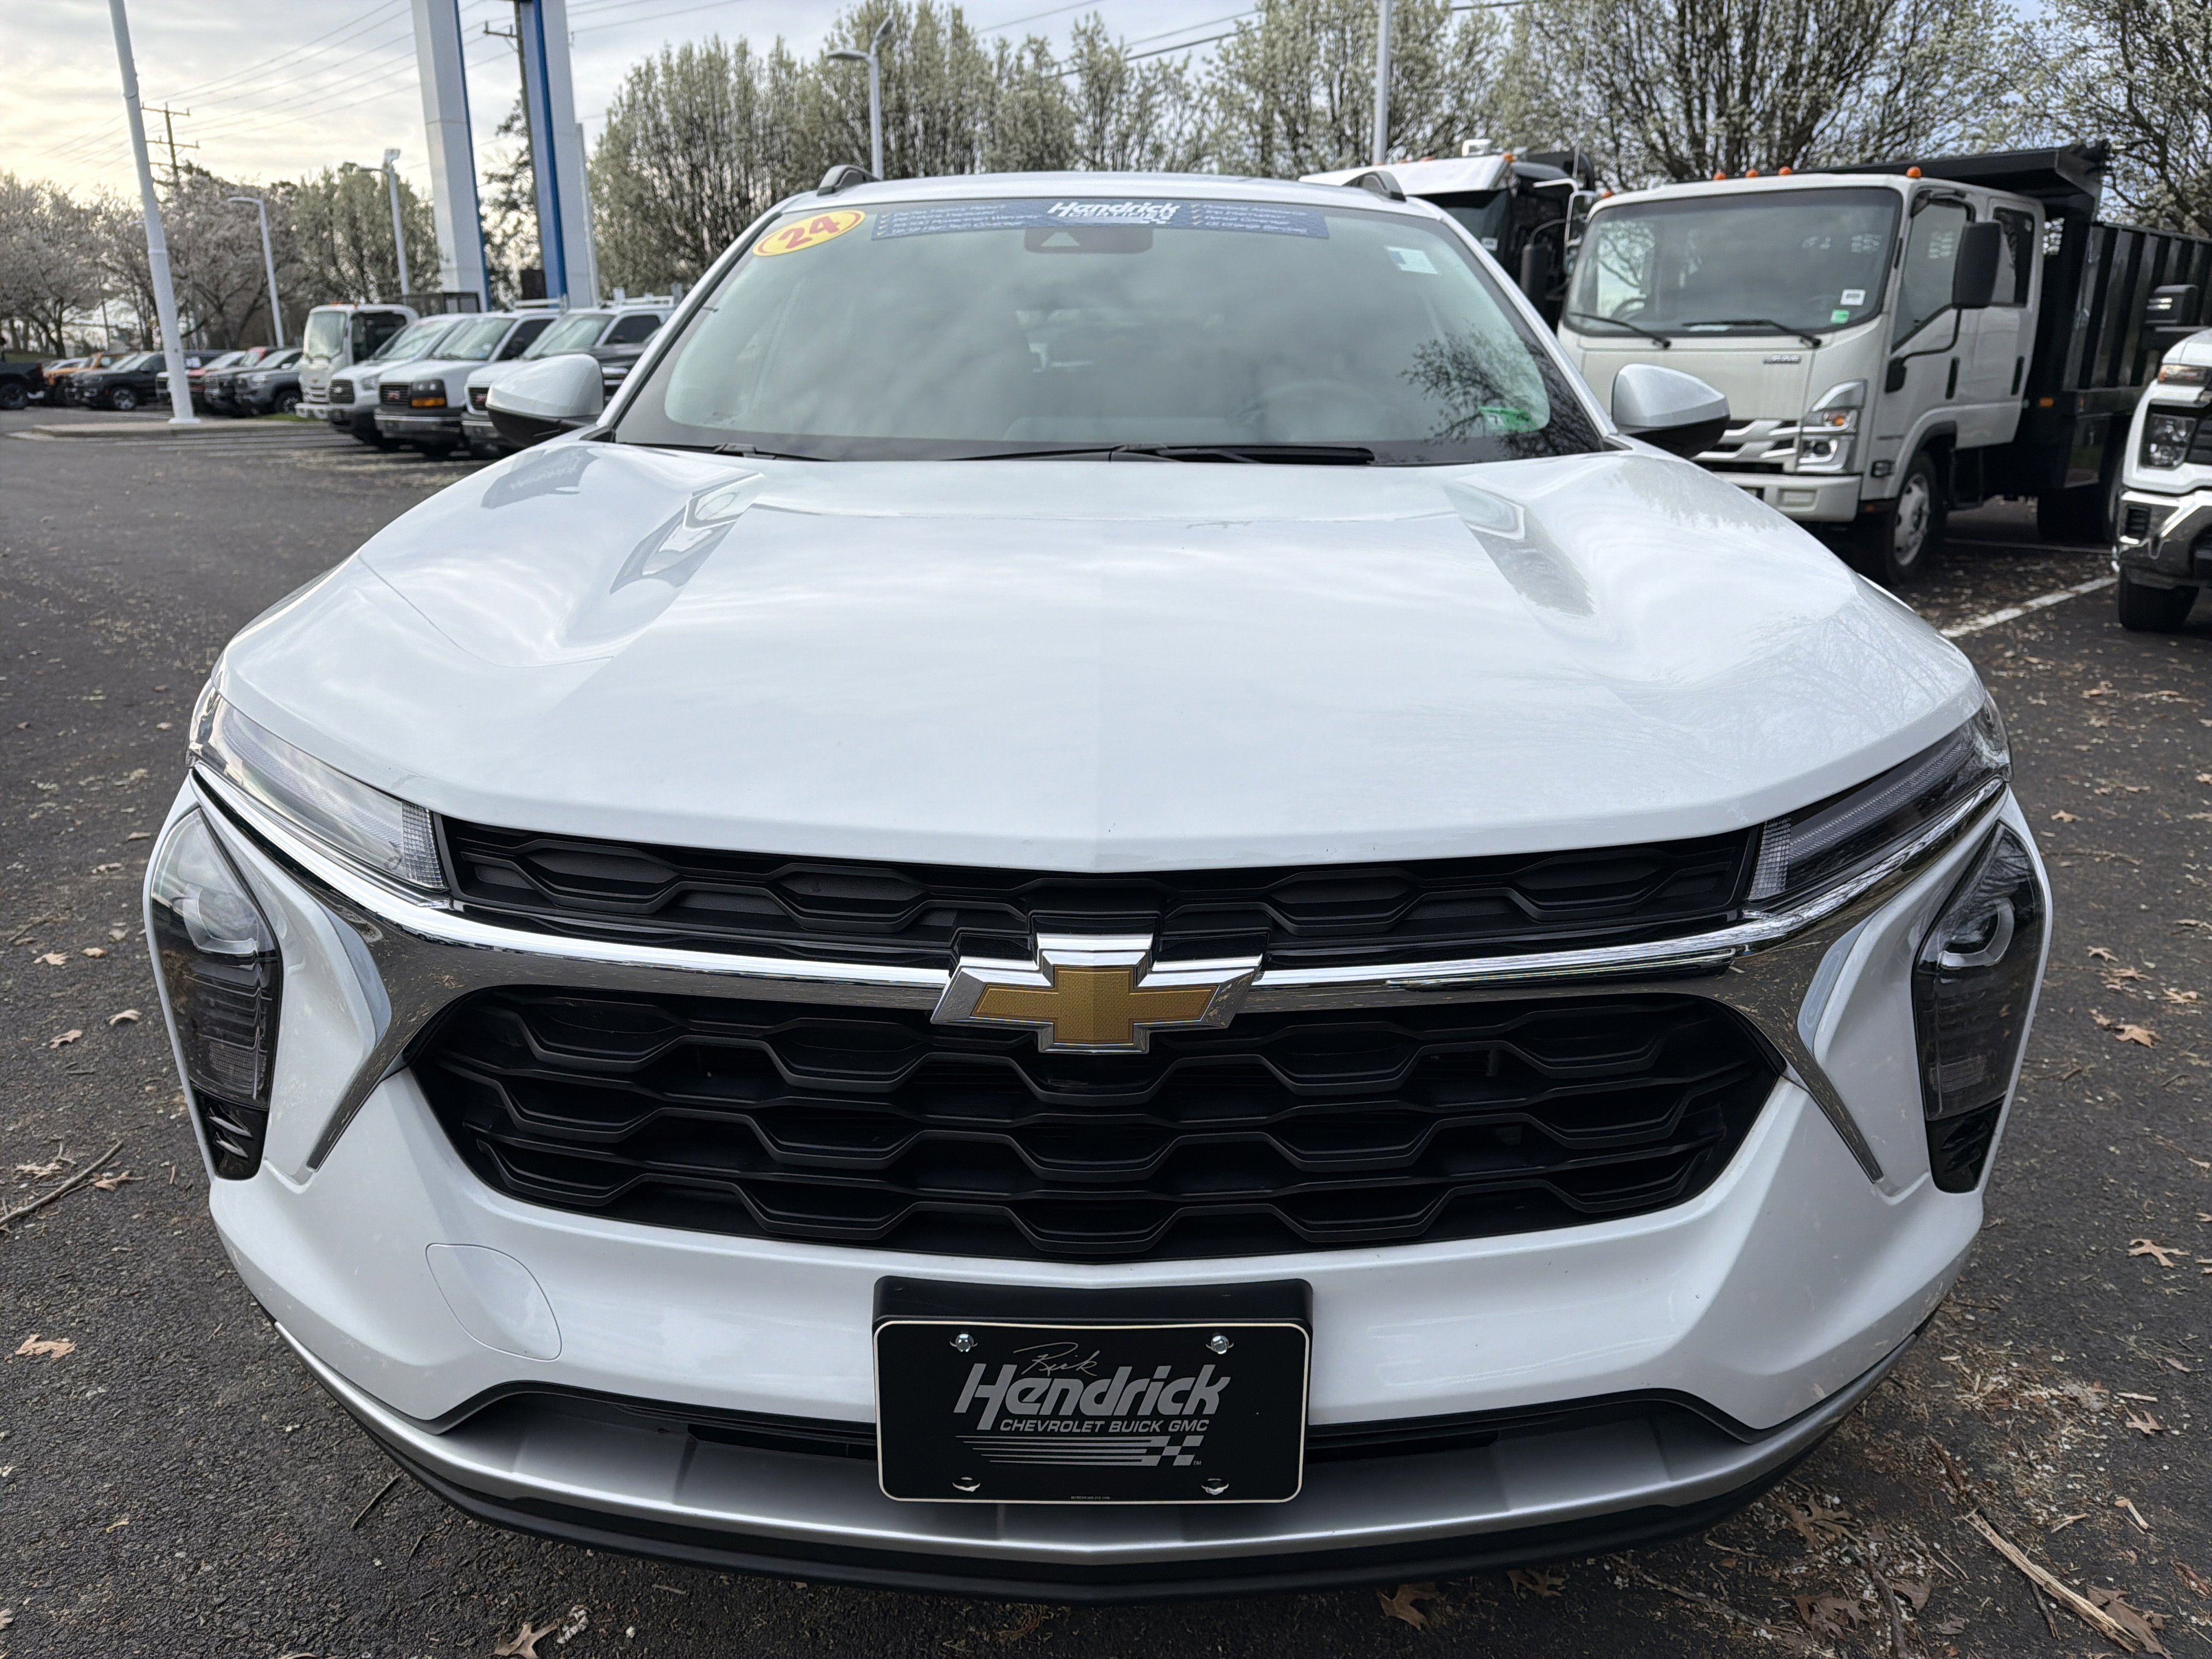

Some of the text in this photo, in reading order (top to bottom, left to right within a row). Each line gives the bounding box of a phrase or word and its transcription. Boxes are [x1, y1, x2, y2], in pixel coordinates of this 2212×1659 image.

[1047, 202, 1181, 217] Hendrick
[778, 216, 840, 249] 24
[953, 1363, 1231, 1431] Hendrick
[1000, 1419, 1210, 1433] CHEVROLET BUICK GMC
